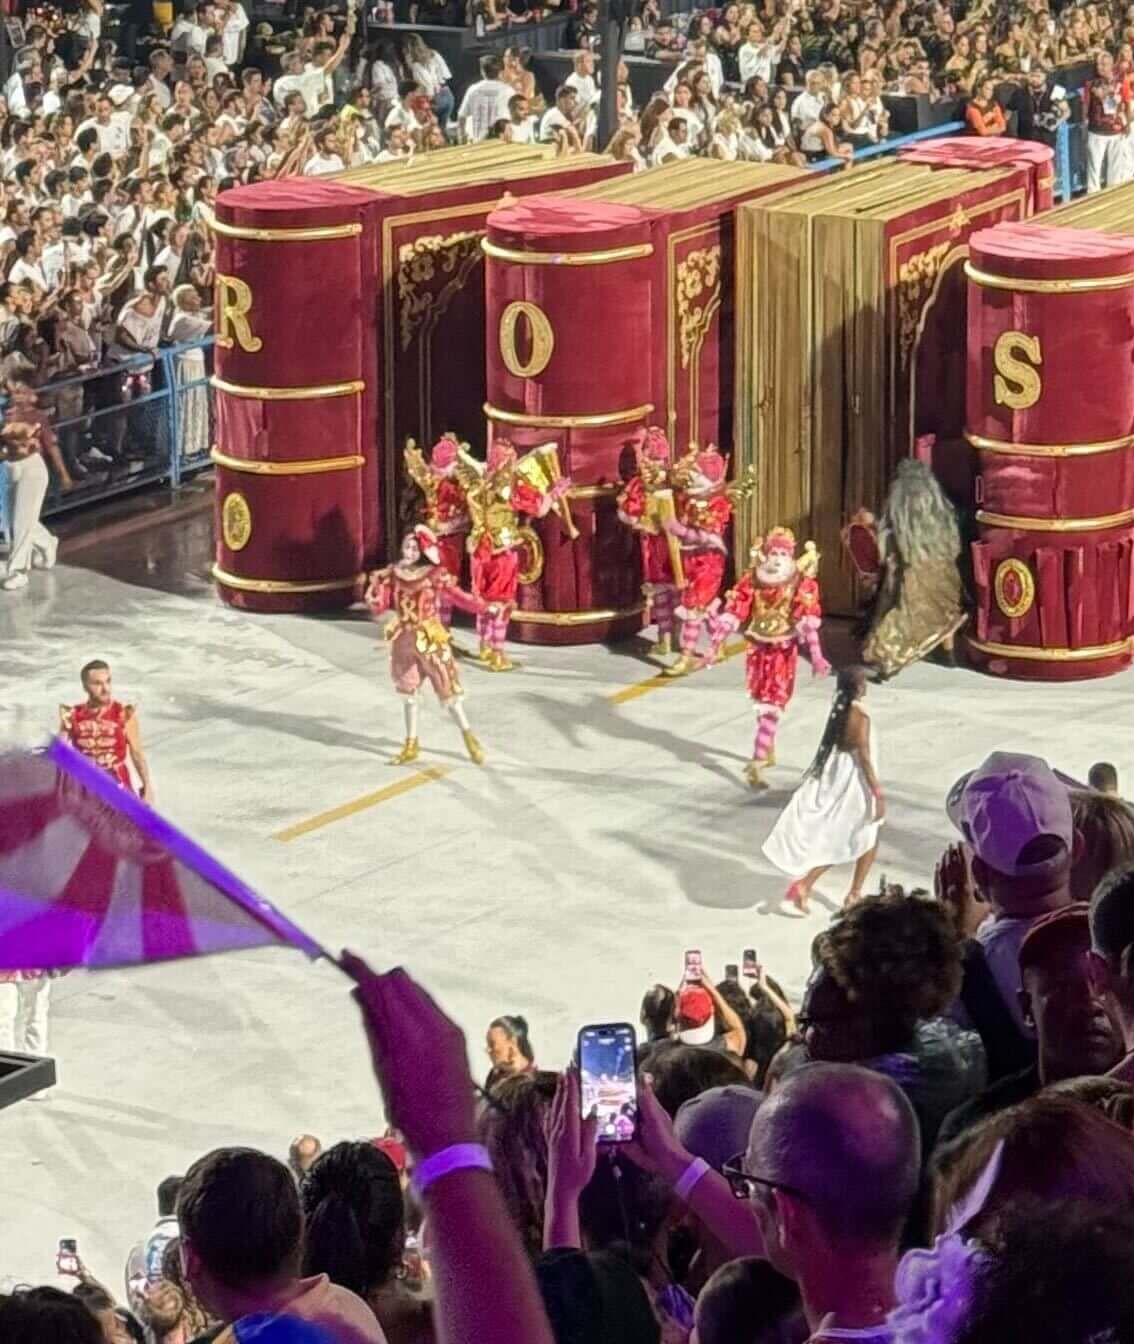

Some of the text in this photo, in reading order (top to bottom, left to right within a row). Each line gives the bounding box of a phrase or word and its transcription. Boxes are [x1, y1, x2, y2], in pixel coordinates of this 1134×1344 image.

[215, 273, 262, 352] R
[500, 301, 554, 377] O
[994, 330, 1042, 409] S
